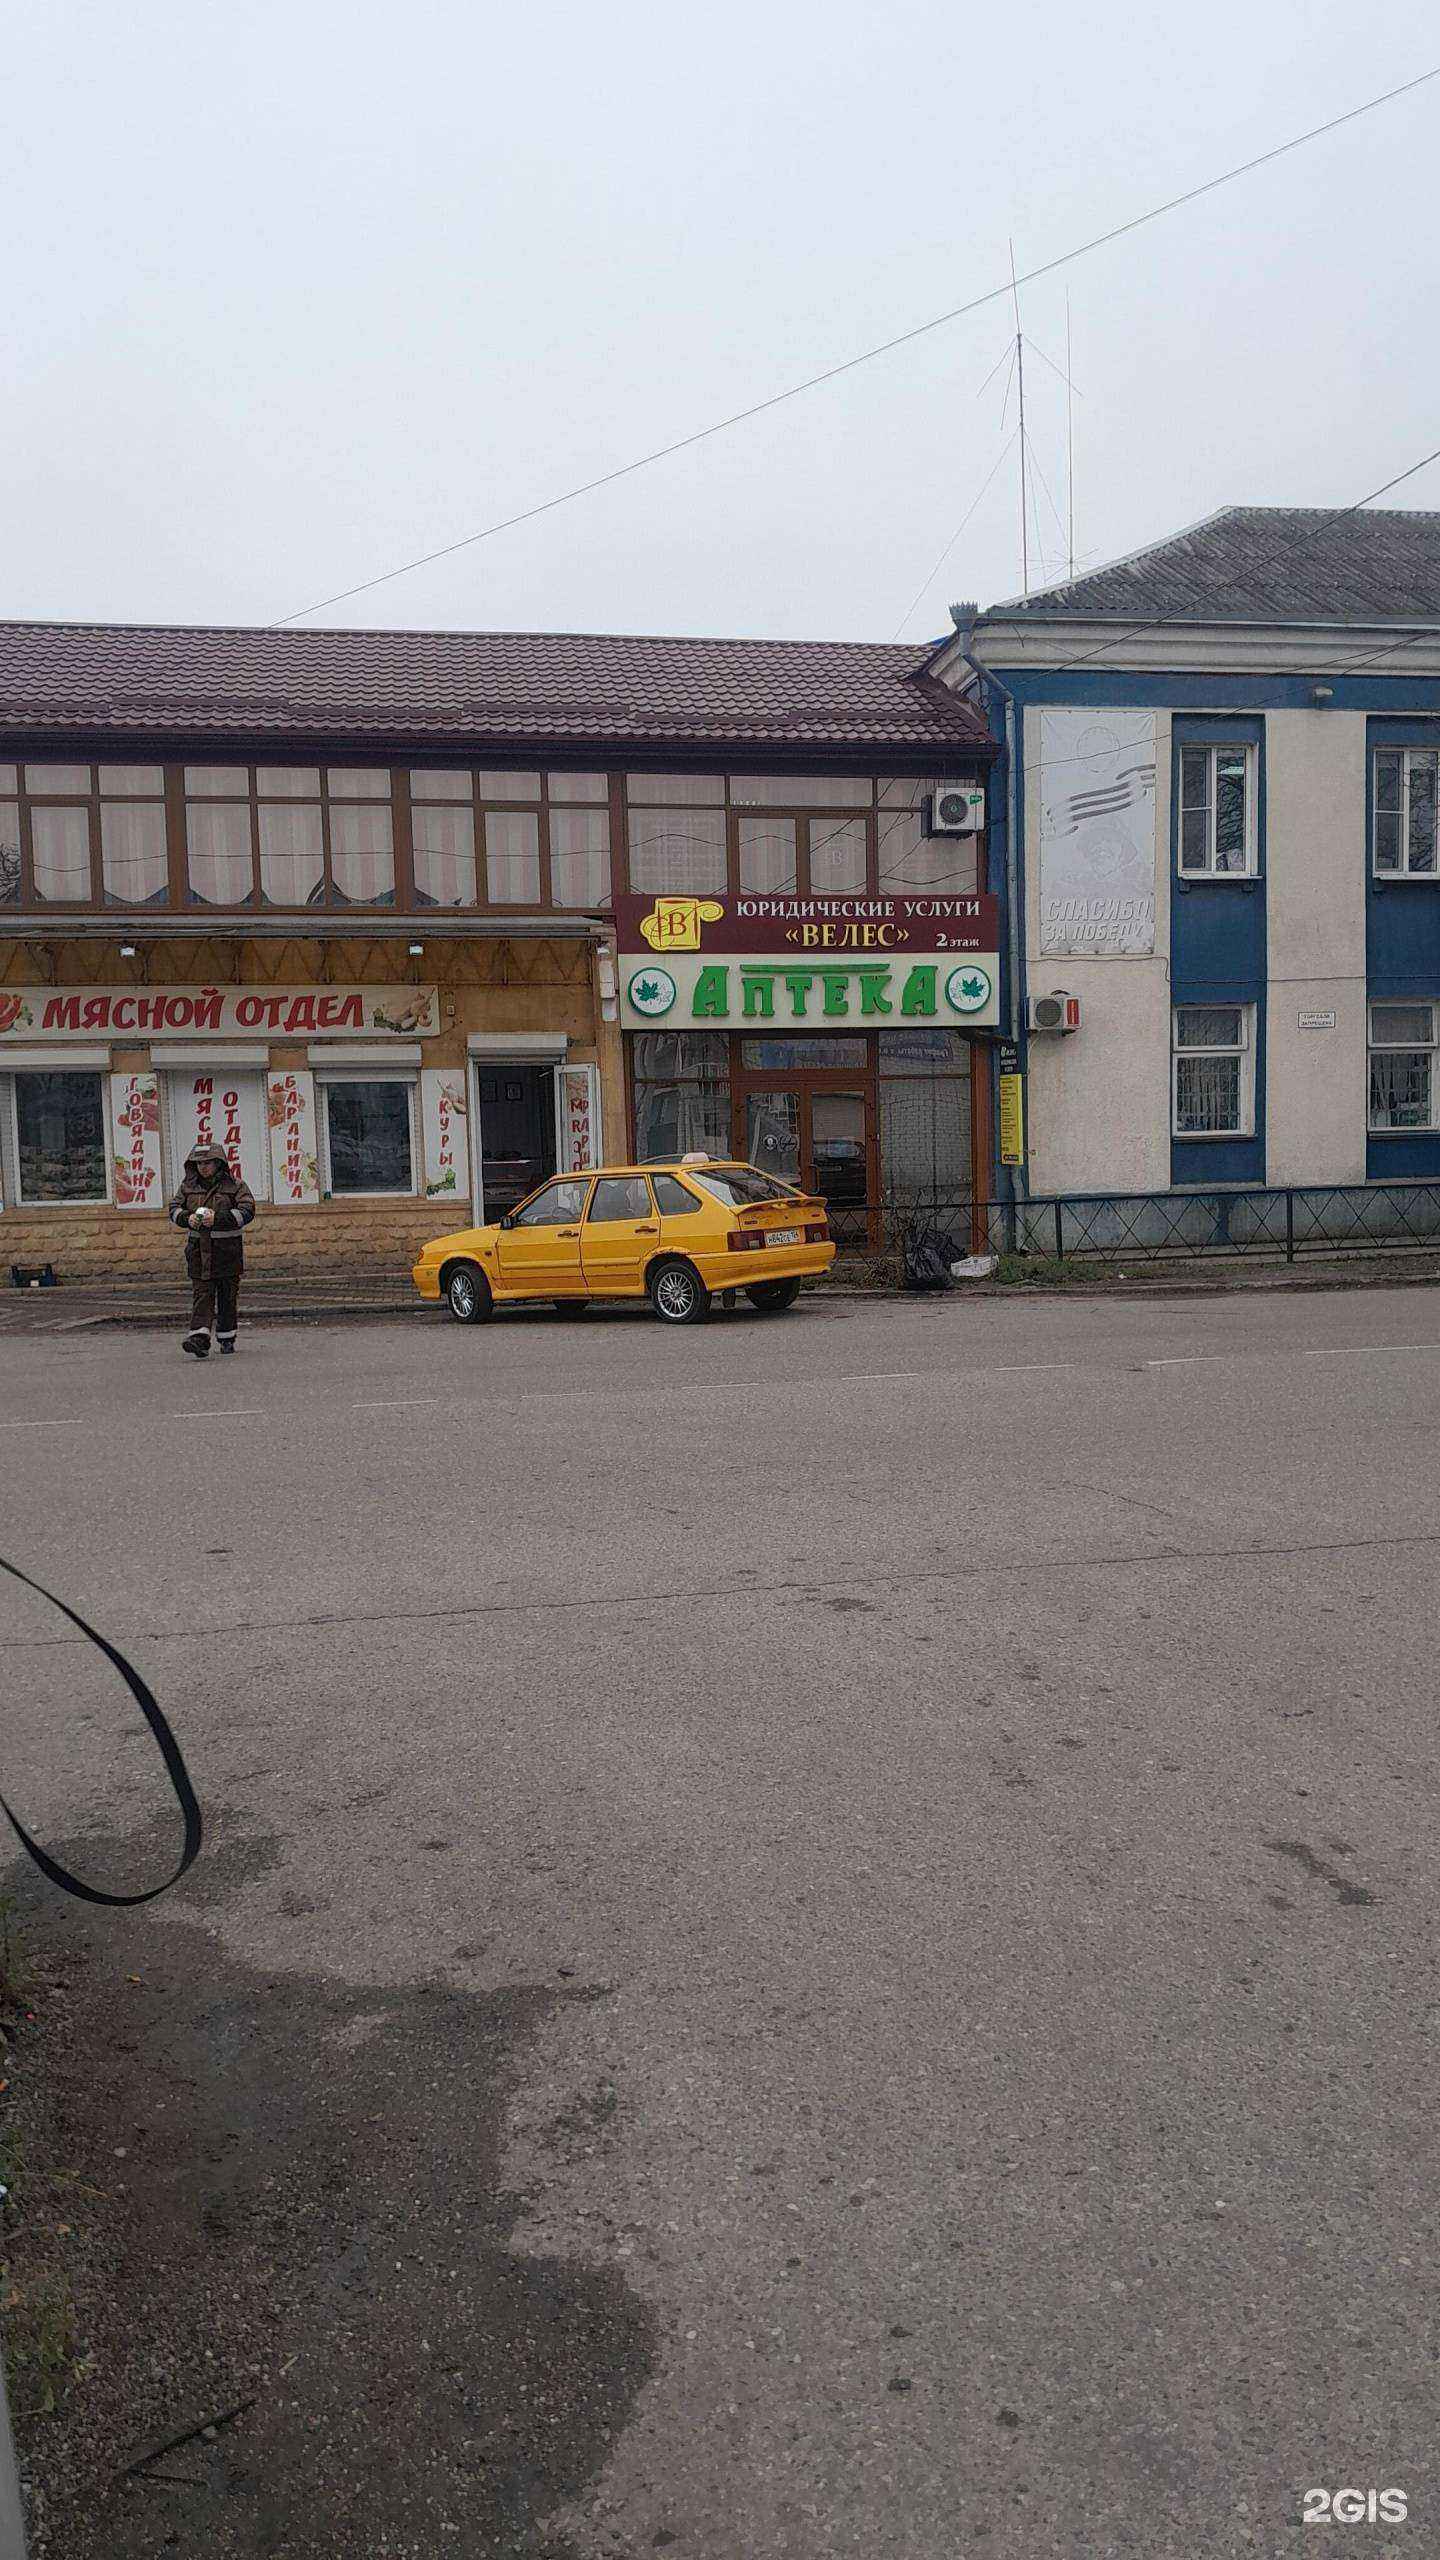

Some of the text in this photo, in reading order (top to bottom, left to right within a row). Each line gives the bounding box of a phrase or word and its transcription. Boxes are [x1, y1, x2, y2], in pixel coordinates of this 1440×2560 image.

[736, 900, 981, 918] ЮРИДИЧЕСКИЕ УСЛУГИ
[785, 922, 910, 948] «ВЕЛЕС»
[42, 986, 365, 1033] МЯСНОЙ ОТДЕЛ
[692, 963, 938, 1016] АПТЕКА
[128, 1076, 146, 1203] ГОВЯДИНА
[193, 1077, 214, 1145] МЯСН
[222, 1091, 243, 1181] ОТДЕЛ
[284, 1075, 303, 1199] БАРАНИНА
[438, 1100, 454, 1166] КУРЫ
